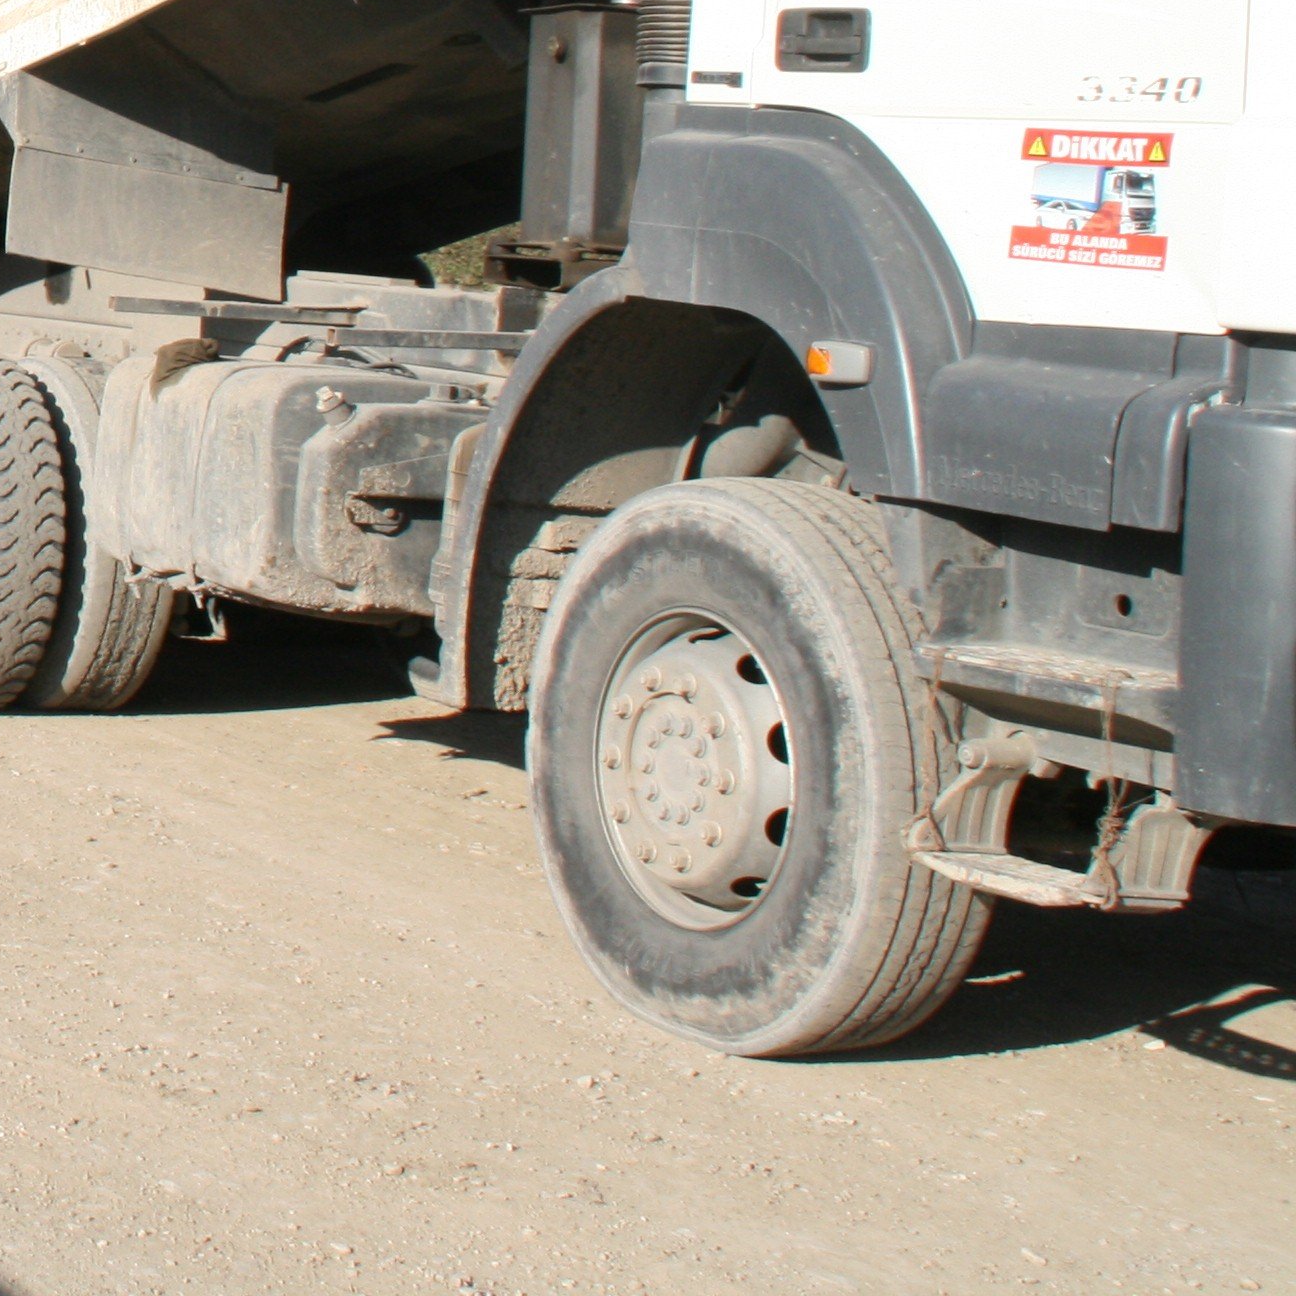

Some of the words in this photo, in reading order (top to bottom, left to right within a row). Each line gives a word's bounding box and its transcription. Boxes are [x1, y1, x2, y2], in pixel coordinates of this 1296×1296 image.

[1077, 76, 1202, 103] 3340
[1049, 232, 1070, 246] BU
[1072, 234, 1128, 251] ALANDA
[1011, 242, 1066, 261] SÜRÜCÜ
[1099, 251, 1163, 269] GÖREMEZ
